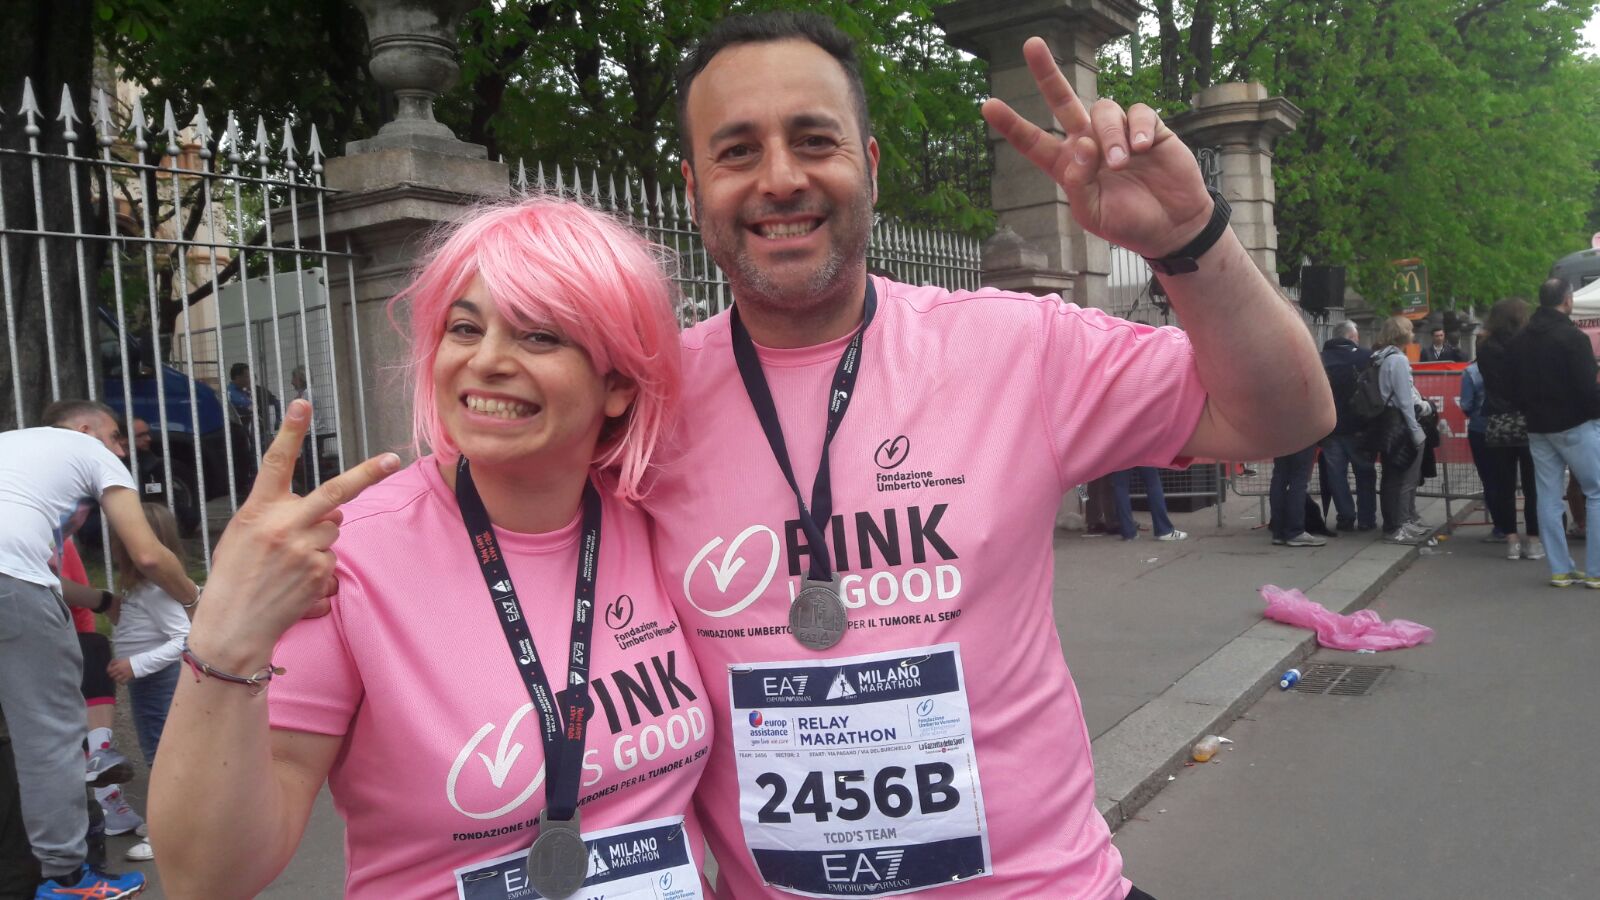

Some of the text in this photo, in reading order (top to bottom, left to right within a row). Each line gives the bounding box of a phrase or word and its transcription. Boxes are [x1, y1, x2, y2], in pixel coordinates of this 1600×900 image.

[876, 470, 933, 482] Fondazione
[877, 474, 966, 492] Umberto Veronesi
[785, 503, 959, 576] PINK
[840, 564, 962, 609] GOOD
[502, 601, 518, 622] EA7
[614, 620, 658, 642] Fondazione
[696, 609, 962, 638] FONDAZIONE UMBERTO PER IL TUMORE AL SENO
[618, 632, 655, 650] Umberto
[575, 642, 585, 665] EA7
[858, 665, 920, 684] MILANO
[555, 650, 697, 734] PINK
[763, 675, 809, 696] EA7
[860, 678, 921, 693] MARATHON
[538, 685, 553, 713] MARATHON
[750, 728, 788, 736] assistance
[764, 719, 787, 728] europ
[798, 715, 849, 730] RELAY
[613, 706, 706, 772] GOOD
[800, 727, 897, 746] MARATHON
[452, 822, 523, 841] FONDAZIONE
[576, 784, 619, 807] VERONESI
[620, 776, 637, 790] PER
[638, 773, 646, 783] IL
[648, 759, 683, 779] TUMORE
[684, 756, 693, 765] AL
[755, 761, 961, 824] 2456B
[823, 827, 897, 844] TCDD'S TEAM
[609, 837, 658, 859] MILANO
[611, 850, 660, 869] MARATHON
[821, 849, 905, 882] EA7
[827, 879, 911, 893] EMPORIO ARMANI
